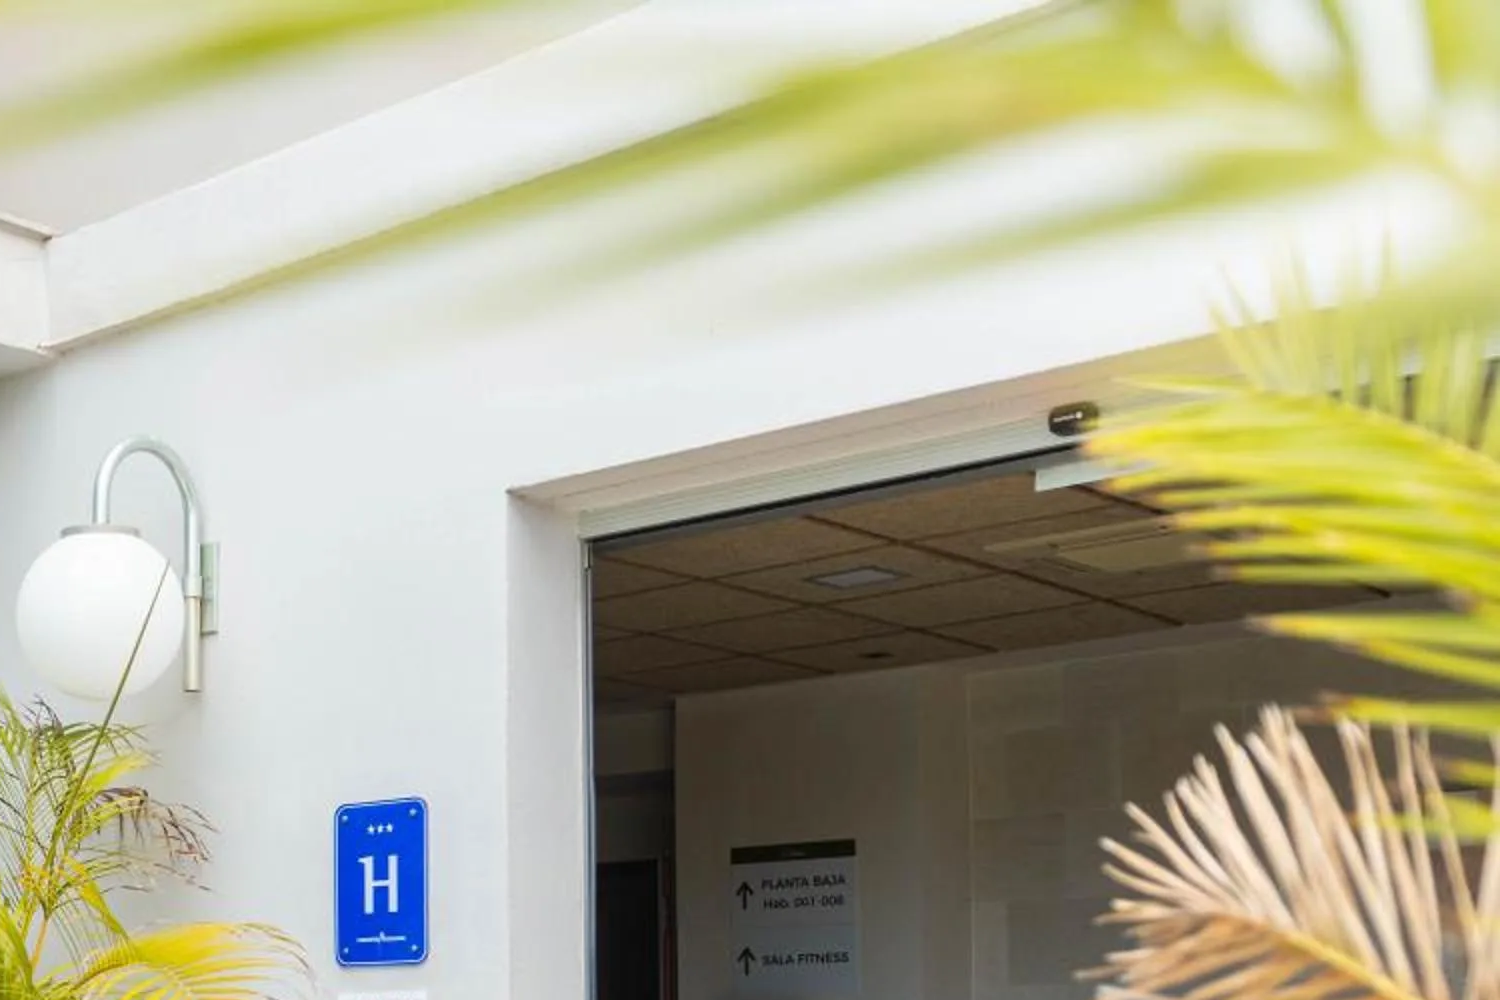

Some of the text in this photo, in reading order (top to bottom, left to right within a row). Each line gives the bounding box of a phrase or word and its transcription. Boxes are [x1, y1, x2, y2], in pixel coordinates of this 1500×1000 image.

[357, 854, 399, 915] H
[761, 873, 846, 890] PLANTA BAJA
[761, 950, 850, 967] SALA FITNESS
